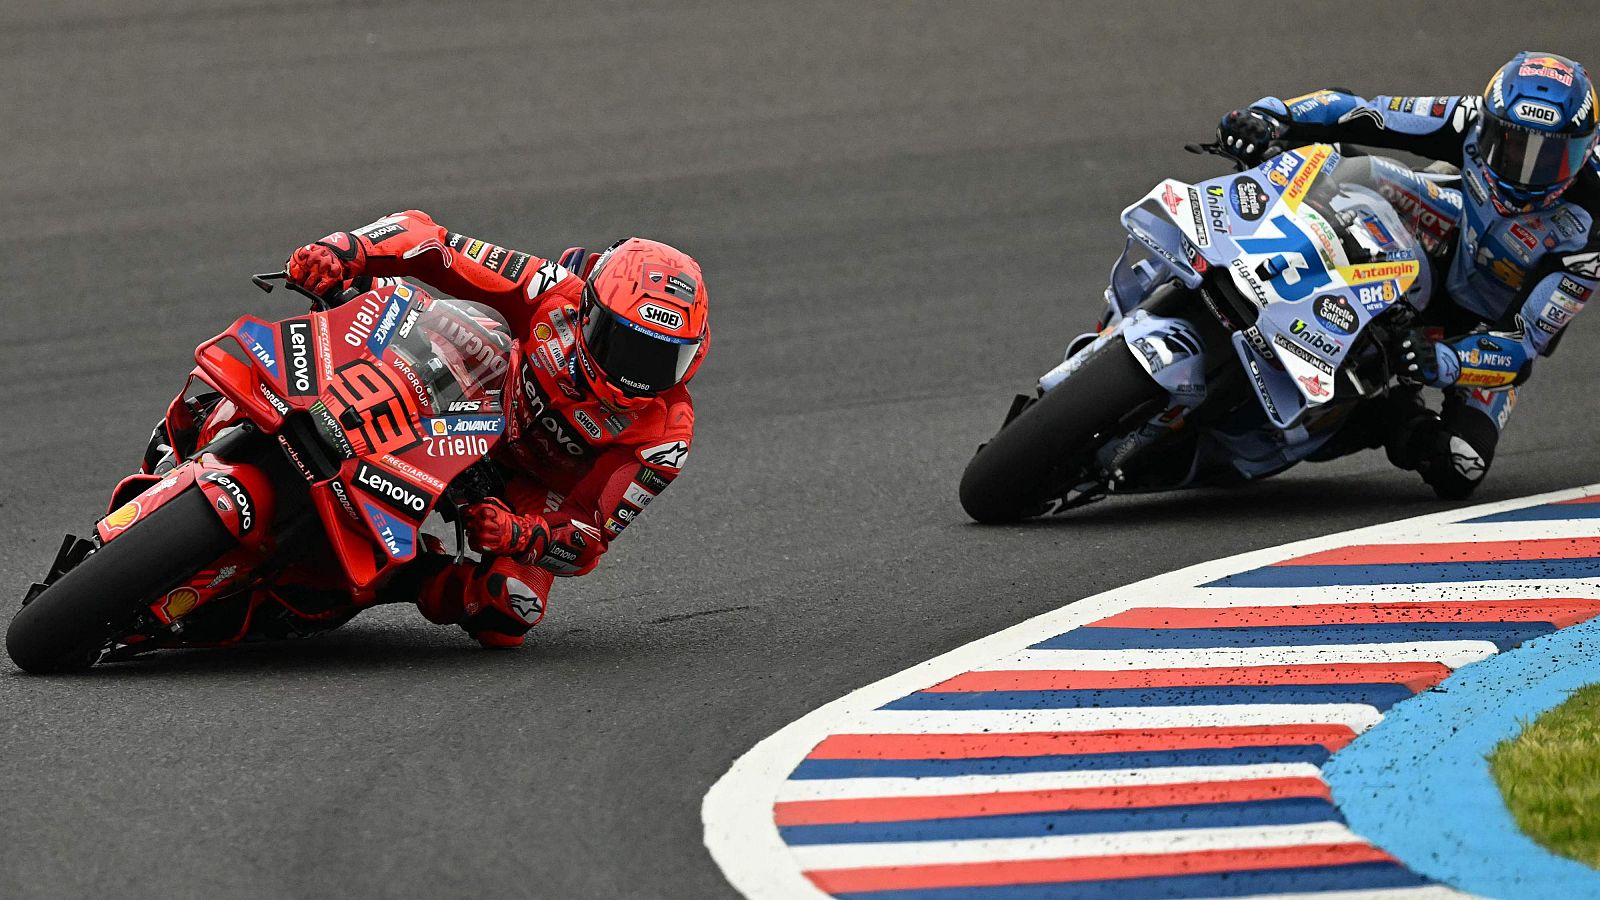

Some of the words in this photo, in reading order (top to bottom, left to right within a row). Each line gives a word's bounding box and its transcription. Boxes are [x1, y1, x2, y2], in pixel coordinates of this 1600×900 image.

[1519, 66, 1547, 77] Red
[1547, 68, 1573, 87] Bull
[1292, 98, 1319, 116] NEWS
[1520, 105, 1555, 122] SHOEI
[1268, 152, 1299, 187] BK8
[1288, 149, 1327, 199] Antangin
[1206, 185, 1228, 235] Unibat
[1237, 183, 1250, 214] Galicia
[1246, 182, 1260, 215] Estrella
[368, 224, 405, 239] Lenovo
[1235, 214, 1333, 302] 73
[1387, 250, 1412, 260] ALEX
[1231, 258, 1269, 308] Gigetta
[1352, 263, 1414, 281] Antangin
[1360, 281, 1394, 304] BK8
[344, 298, 381, 347] riello
[373, 299, 401, 345] ADVANCE
[398, 308, 420, 340] WRS
[644, 306, 680, 327] SHOEI
[1320, 306, 1350, 330] Galicia
[1321, 298, 1354, 323] Estrella
[634, 325, 655, 337] Estrella
[1246, 325, 1274, 360] BOLD
[1289, 318, 1341, 357] Unibat
[252, 342, 276, 368] TIM
[289, 323, 310, 391] Lenovo
[318, 315, 334, 381] FRECCIAROSSA
[552, 347, 566, 369] riello
[1287, 343, 1312, 361] GLOW
[1313, 359, 1332, 375] MEN
[1483, 354, 1512, 367] NEWS
[393, 357, 429, 407] VARGROUP
[620, 376, 650, 391] Insta360
[259, 383, 289, 416] CARRERA
[448, 401, 481, 412] WRS
[522, 363, 584, 455] Lenovo
[321, 411, 352, 458] MONSTER
[453, 419, 499, 431] ADVANCE
[576, 411, 600, 436] SHOEI
[277, 434, 315, 481] aruba.it
[438, 436, 489, 456] riello
[381, 454, 445, 490] FRECCIAROSSA
[206, 472, 251, 530] Lenovo
[358, 465, 425, 511] Lenovo
[381, 526, 400, 555] TIM
[550, 544, 577, 561] Lenovo
